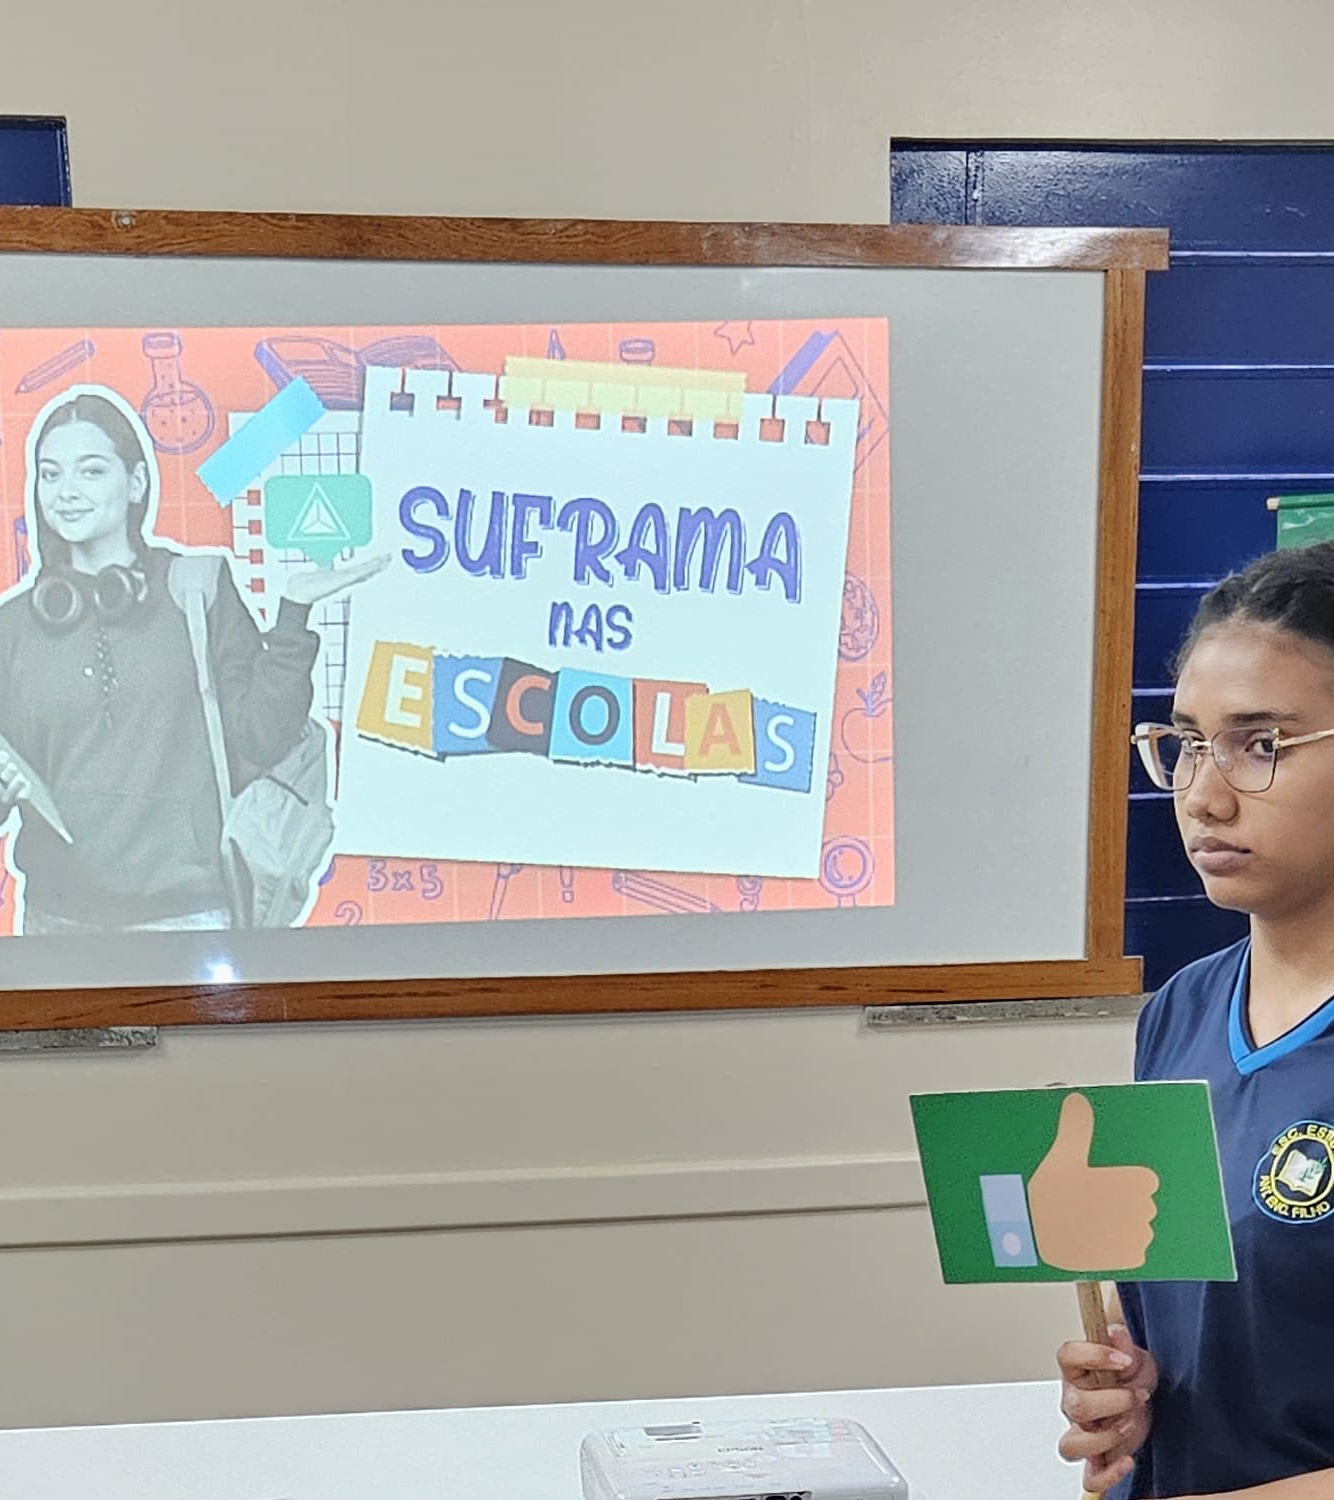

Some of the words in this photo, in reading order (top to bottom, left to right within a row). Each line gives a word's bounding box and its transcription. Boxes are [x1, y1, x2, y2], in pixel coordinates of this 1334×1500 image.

[398, 485, 803, 604] SUFRAMA
[547, 601, 634, 652] NAS
[383, 653, 797, 775] ESCOLAS
